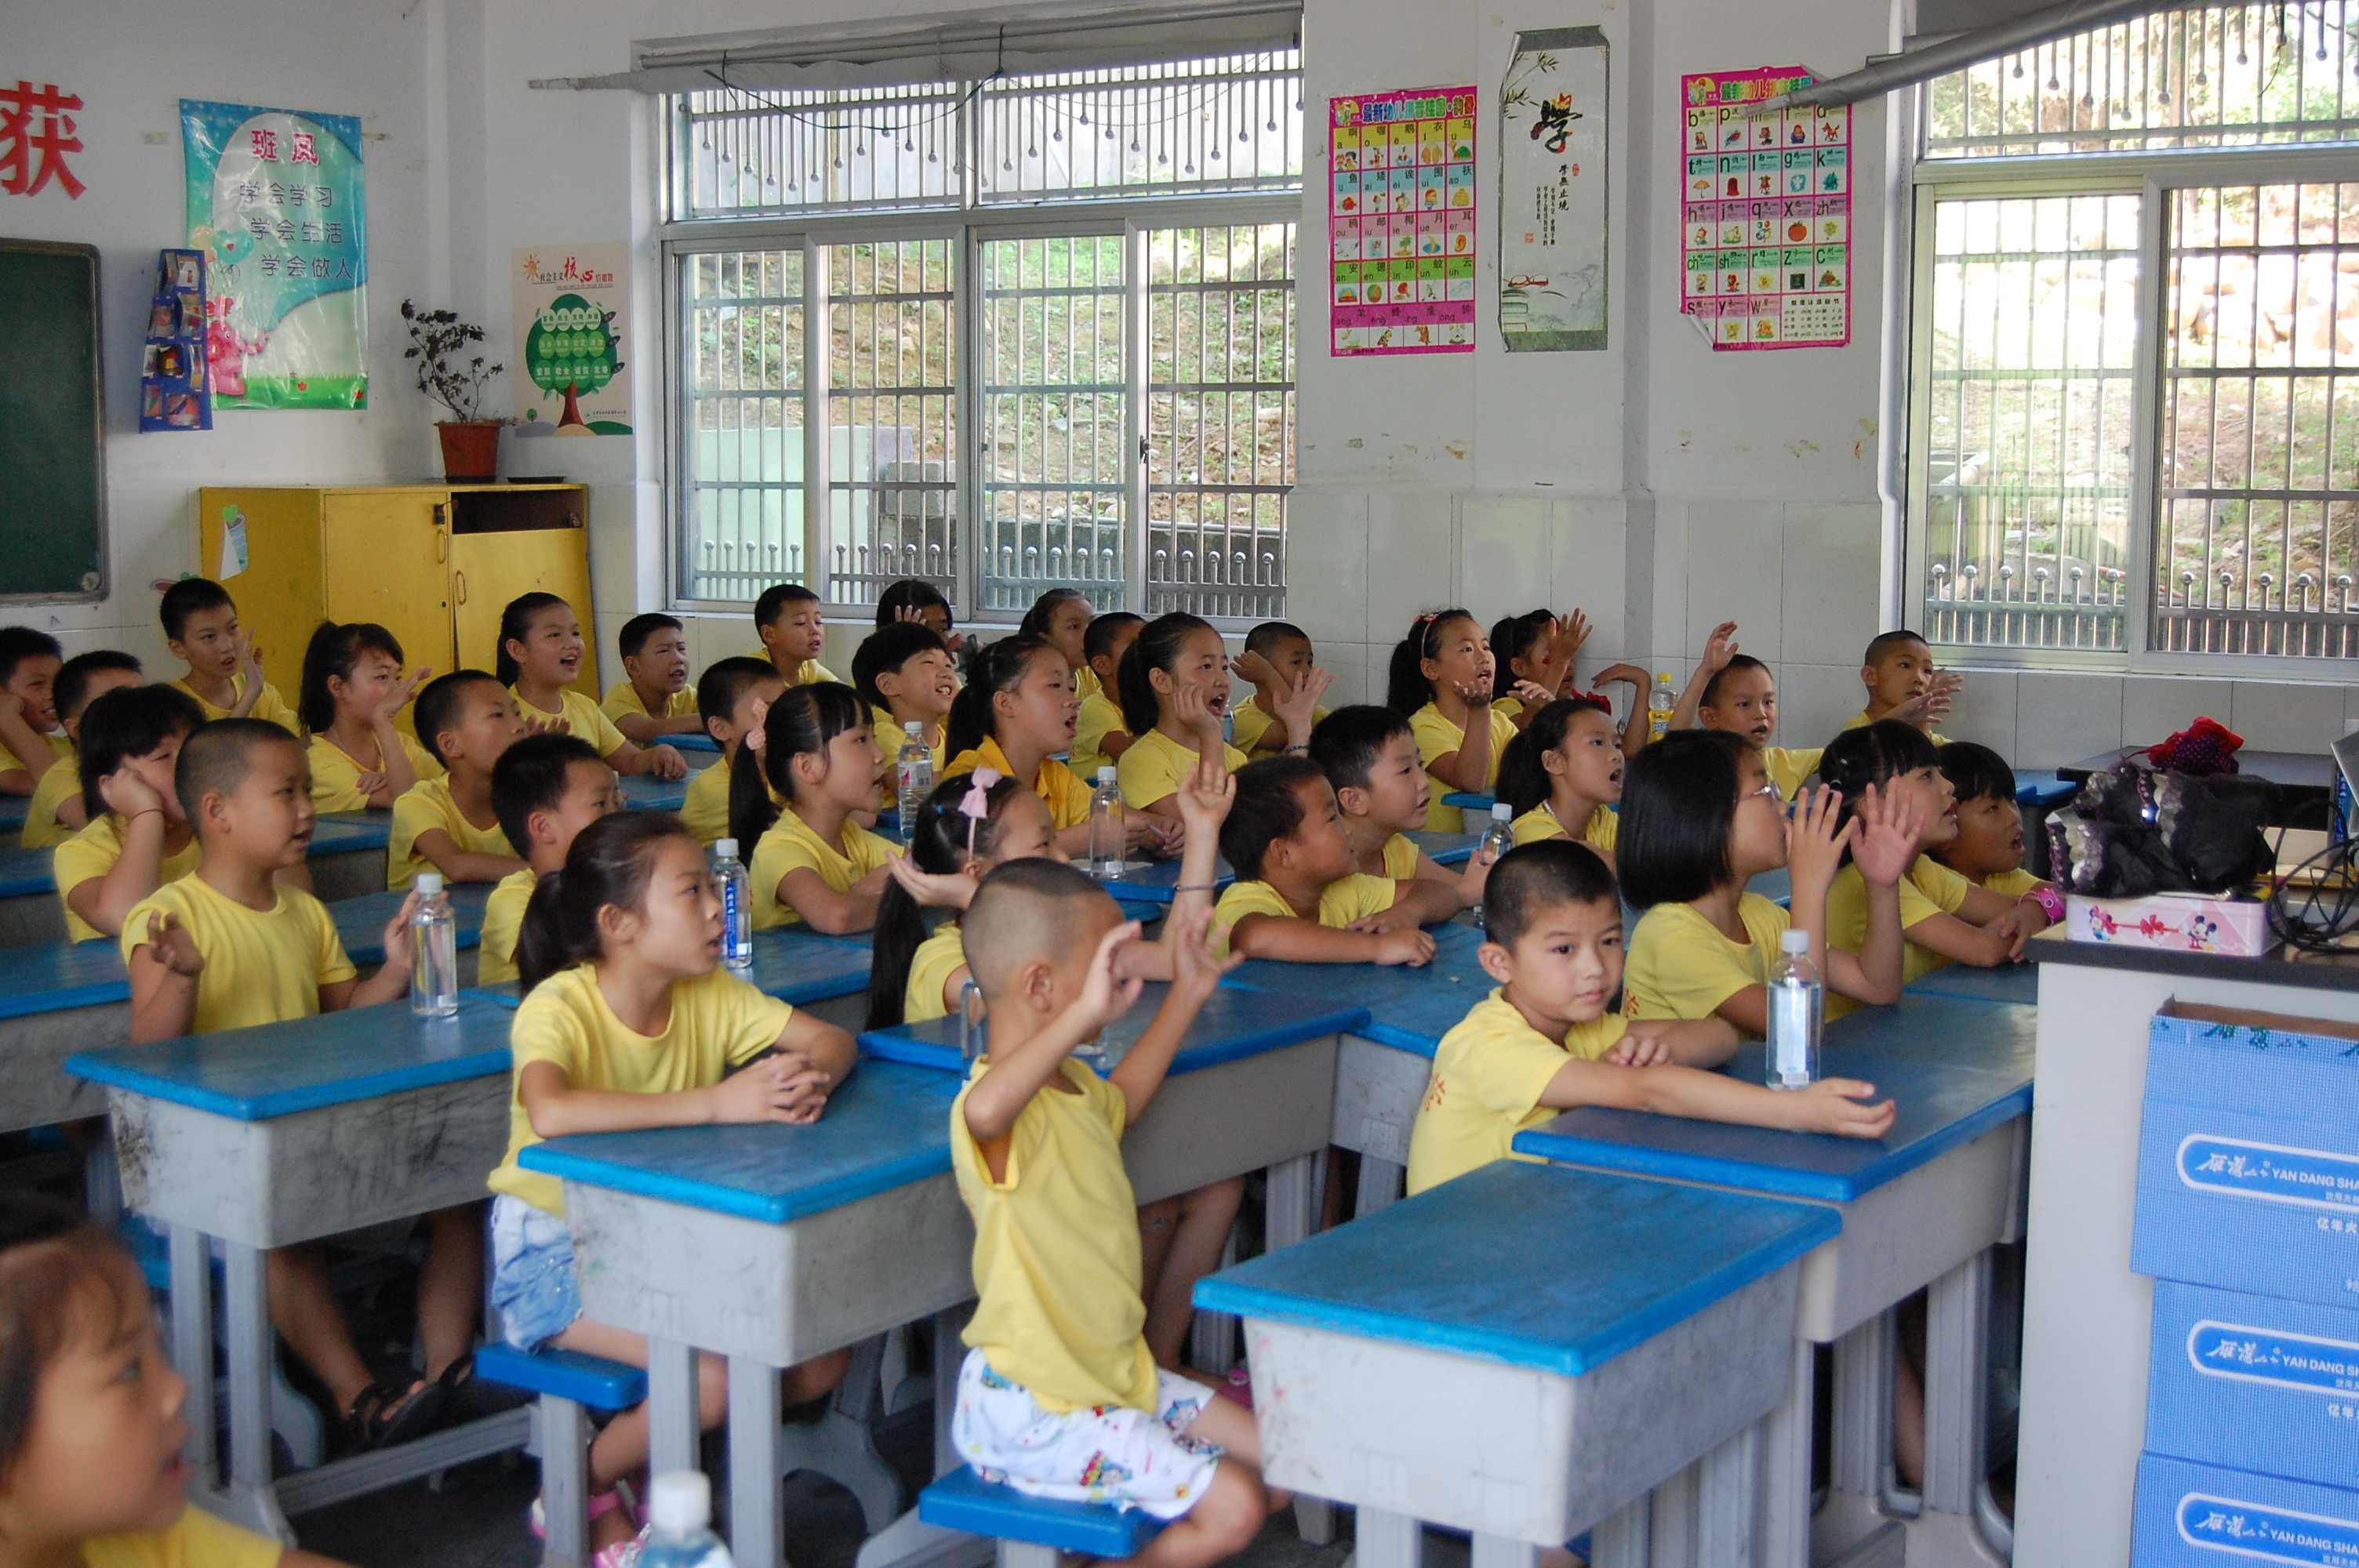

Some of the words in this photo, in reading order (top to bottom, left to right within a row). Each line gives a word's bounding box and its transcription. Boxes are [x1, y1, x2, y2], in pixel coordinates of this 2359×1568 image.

[1688, 109, 1698, 127] b
[1719, 107, 1731, 125] p
[1434, 122, 1443, 132] 衣
[0, 80, 87, 201] 获
[251, 129, 319, 164] 班风
[1688, 159, 1696, 175] t
[1719, 156, 1730, 172] n
[1784, 154, 1793, 169] g
[1816, 150, 1826, 167] k
[1349, 174, 1358, 183] 鱼
[1376, 171, 1386, 181] 矮
[1434, 166, 1443, 177] 围
[1421, 179, 1429, 187] ui
[240, 181, 333, 208] 学会学习
[1434, 212, 1443, 223] 月
[1462, 211, 1472, 222] 耳
[1688, 208, 1697, 223] h
[1720, 204, 1725, 221] j
[1751, 202, 1761, 220] q
[1816, 201, 1829, 216] zh
[251, 217, 342, 244] 学会生活
[261, 254, 353, 279] 学会做人
[1349, 263, 1358, 273] 安
[1405, 260, 1415, 270] 印
[1433, 258, 1443, 269] 蚊
[1463, 257, 1472, 267] 云
[1688, 256, 1699, 270] ch
[1719, 254, 1730, 269] sh
[1751, 252, 1758, 268] r
[1719, 300, 1726, 315] y
[1371, 317, 1387, 325] eng
[1439, 313, 1456, 322] ong
[2273, 1168, 2298, 1181] YAN
[2299, 1172, 2335, 1187] DANG
[2282, 1355, 2306, 1368] YAN
[2310, 1360, 2344, 1374] DANG
[2328, 1403, 2359, 1420] 亿年
[2270, 1529, 2295, 1544] YAN
[2297, 1534, 2332, 1551] DANG
